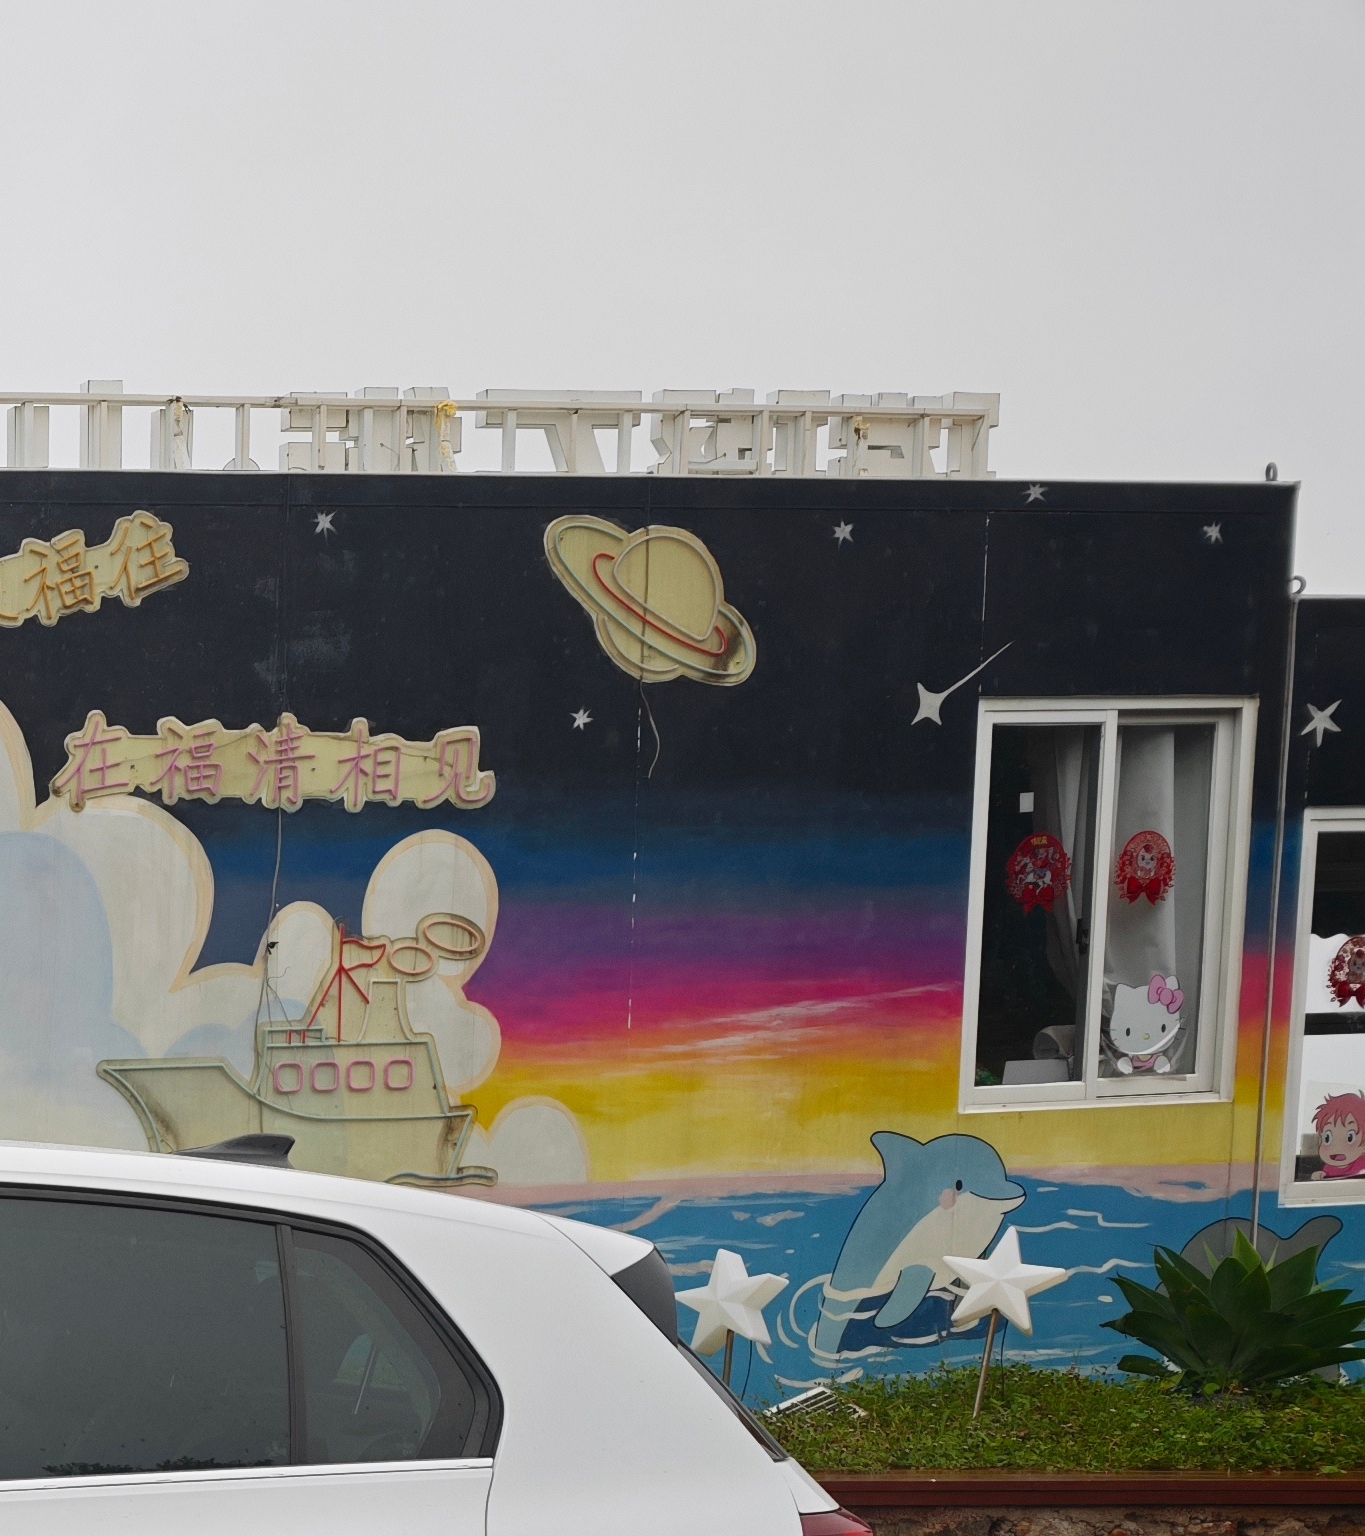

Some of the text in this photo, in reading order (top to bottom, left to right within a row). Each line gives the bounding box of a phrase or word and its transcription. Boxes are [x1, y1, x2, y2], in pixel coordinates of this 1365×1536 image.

[60, 719, 493, 807] 在福清相见
